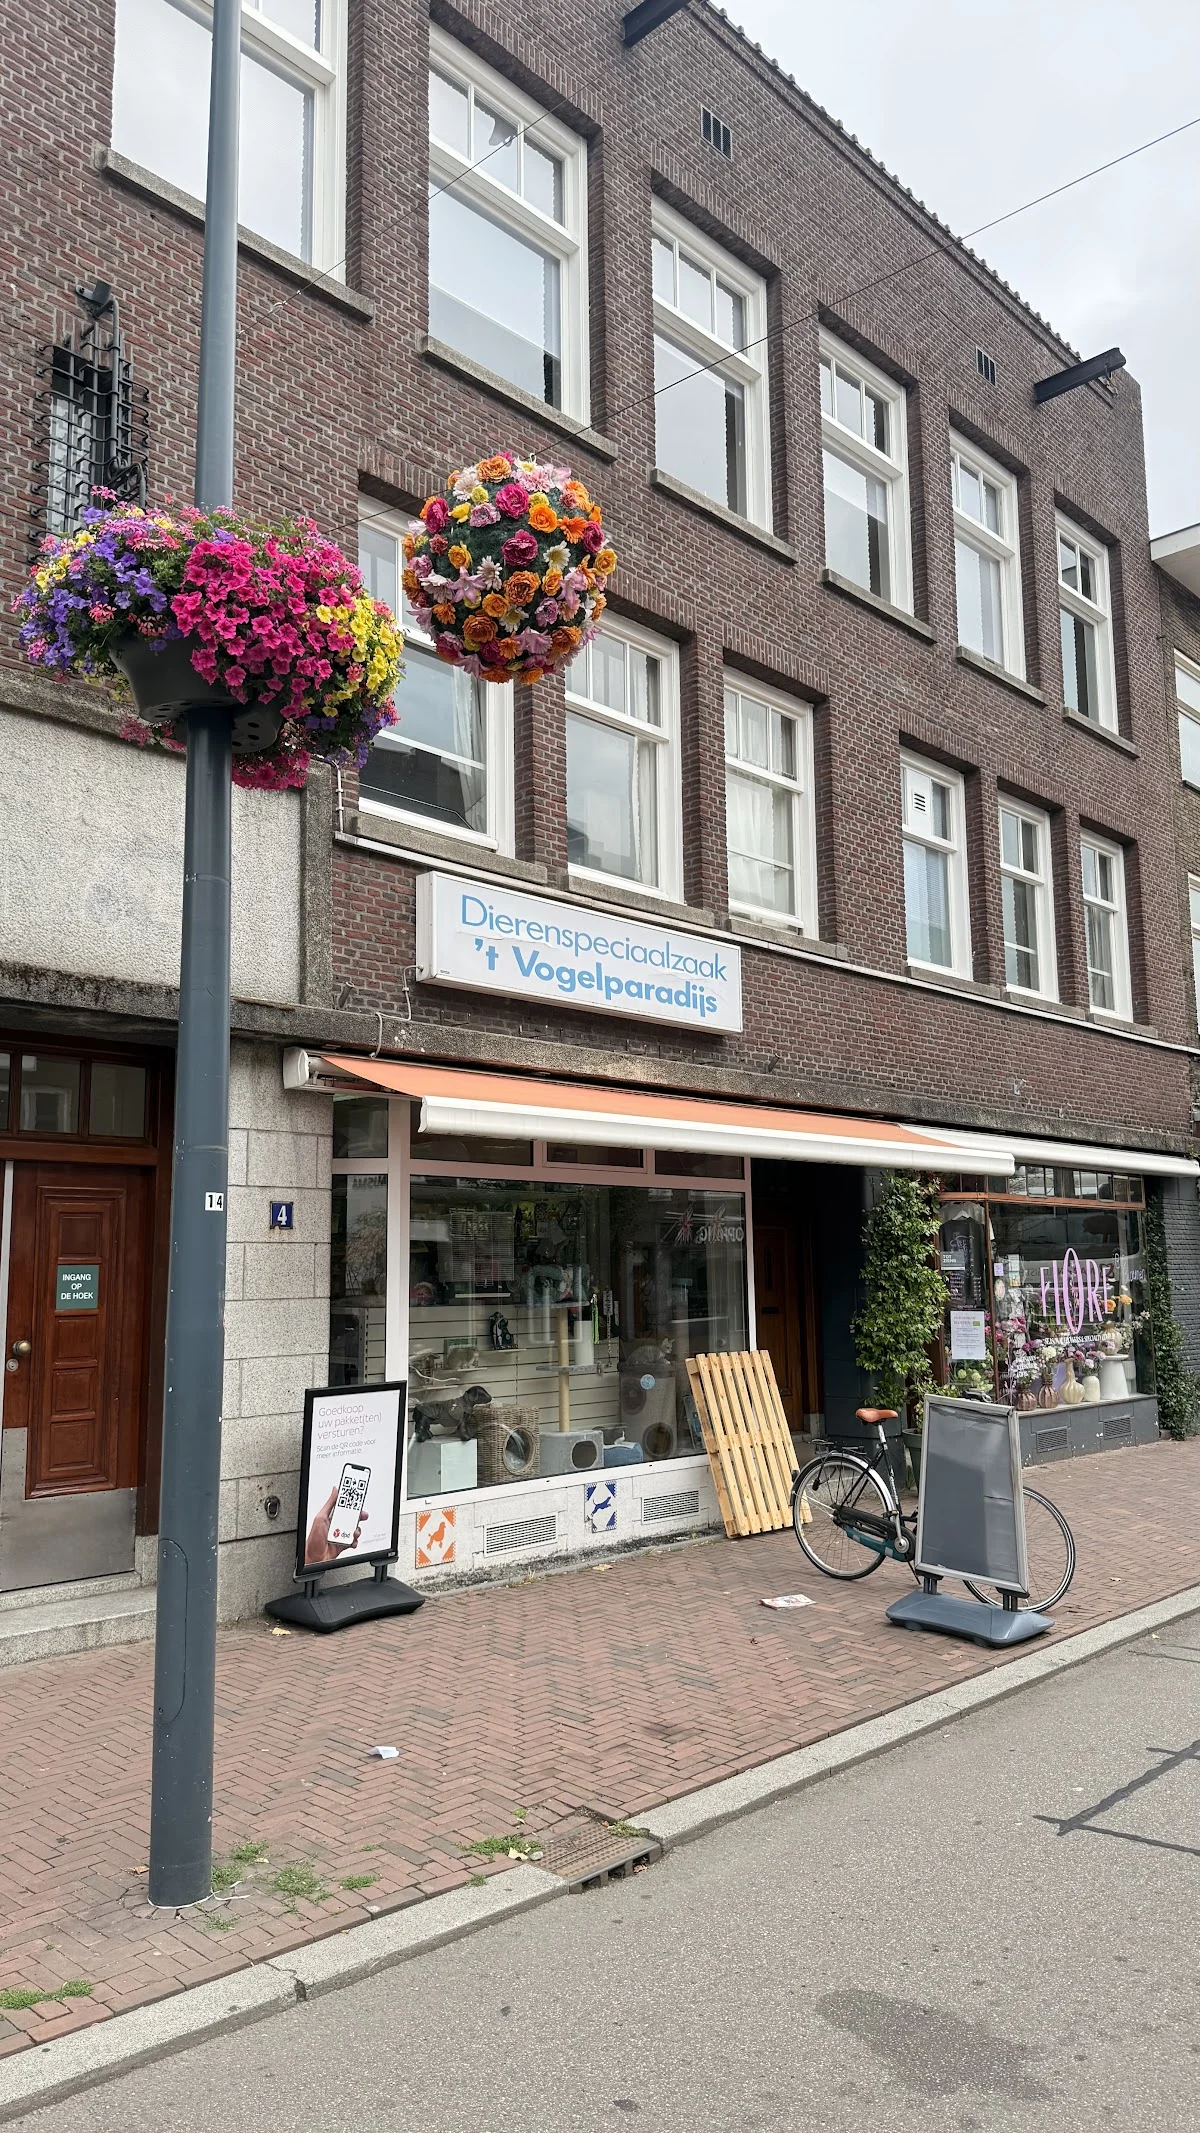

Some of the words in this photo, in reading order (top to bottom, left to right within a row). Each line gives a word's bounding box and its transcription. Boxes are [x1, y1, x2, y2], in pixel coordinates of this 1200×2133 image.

[461, 894, 727, 981] Dierenspeciaalzaak
[512, 946, 718, 1018] Vogelparadijs
[208, 1194, 222, 1210] 14
[277, 1205, 287, 1226] 4
[61, 1292, 71, 1300] DE
[1040, 1248, 1113, 1335] FIORE
[319, 1404, 364, 1416] Goedkoop
[318, 1420, 332, 1428] uw
[334, 1412, 382, 1428] pakket(ten)
[318, 1426, 365, 1440] versturen?
[349, 1440, 363, 1448] code
